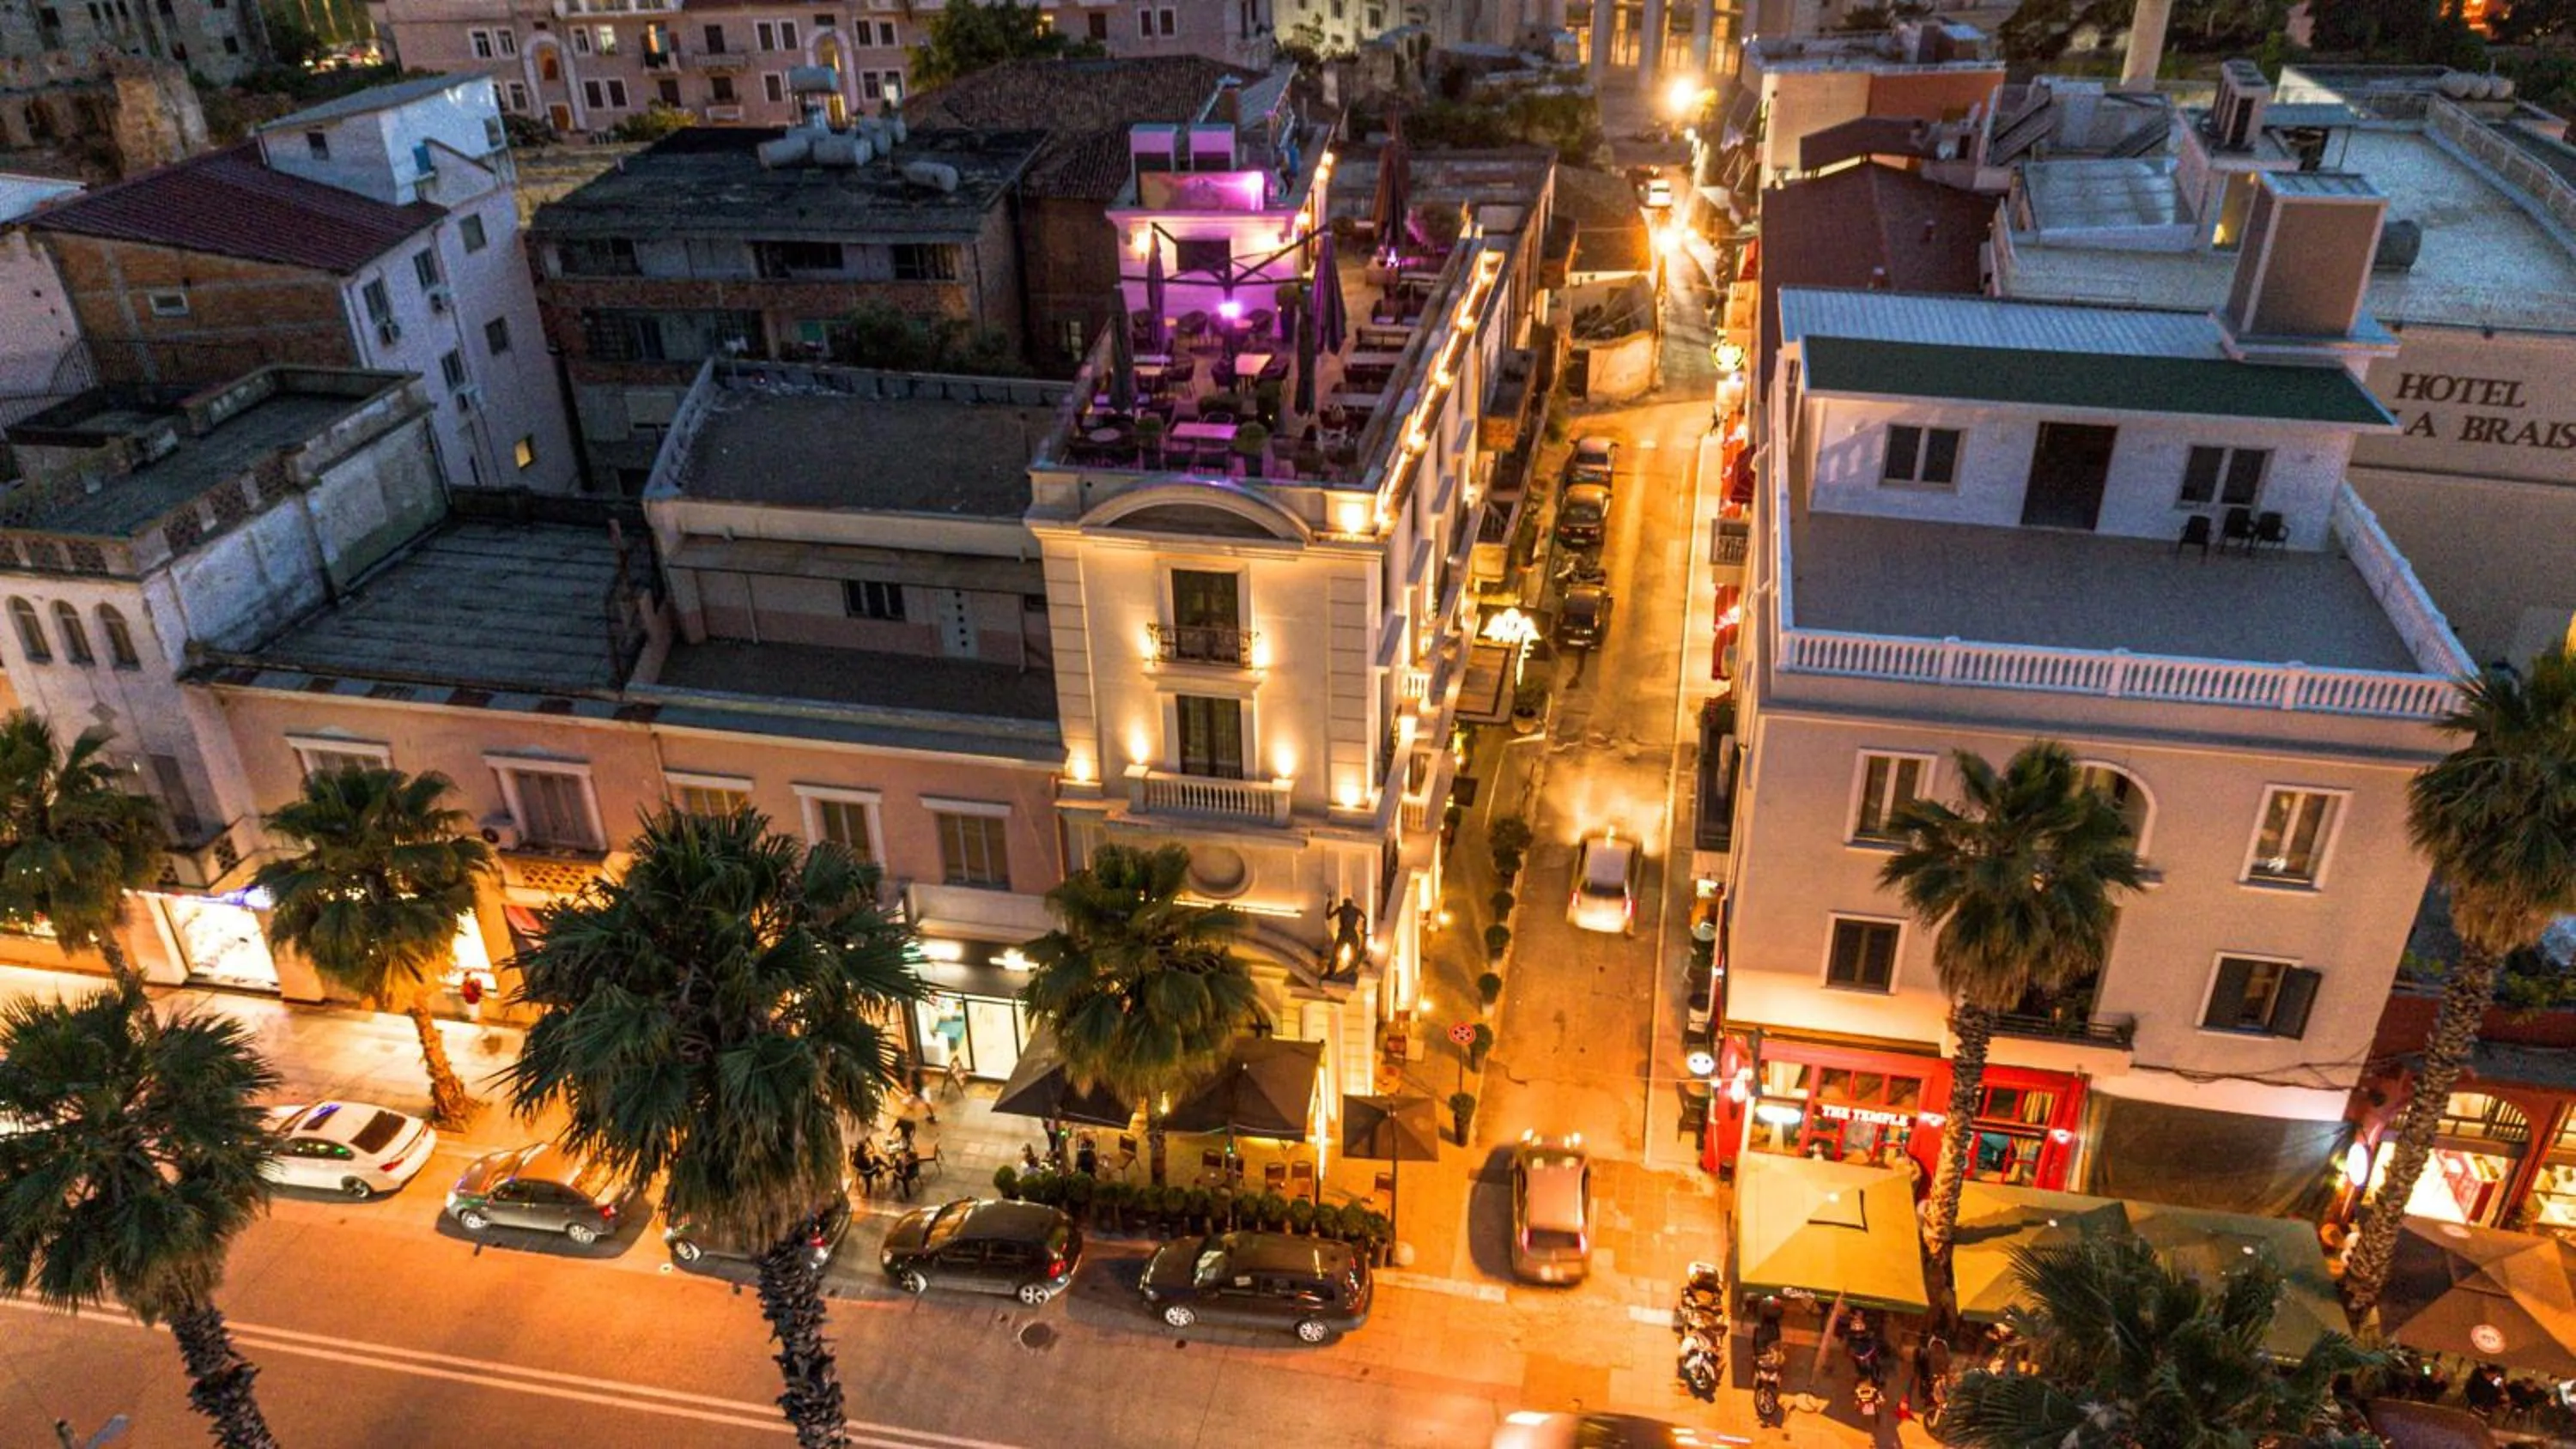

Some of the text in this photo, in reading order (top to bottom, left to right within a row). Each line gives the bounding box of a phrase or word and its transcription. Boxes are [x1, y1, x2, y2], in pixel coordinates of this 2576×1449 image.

[2395, 373, 2526, 409] HOTEL
[1821, 1104, 1909, 1127] THE TEMPLE
